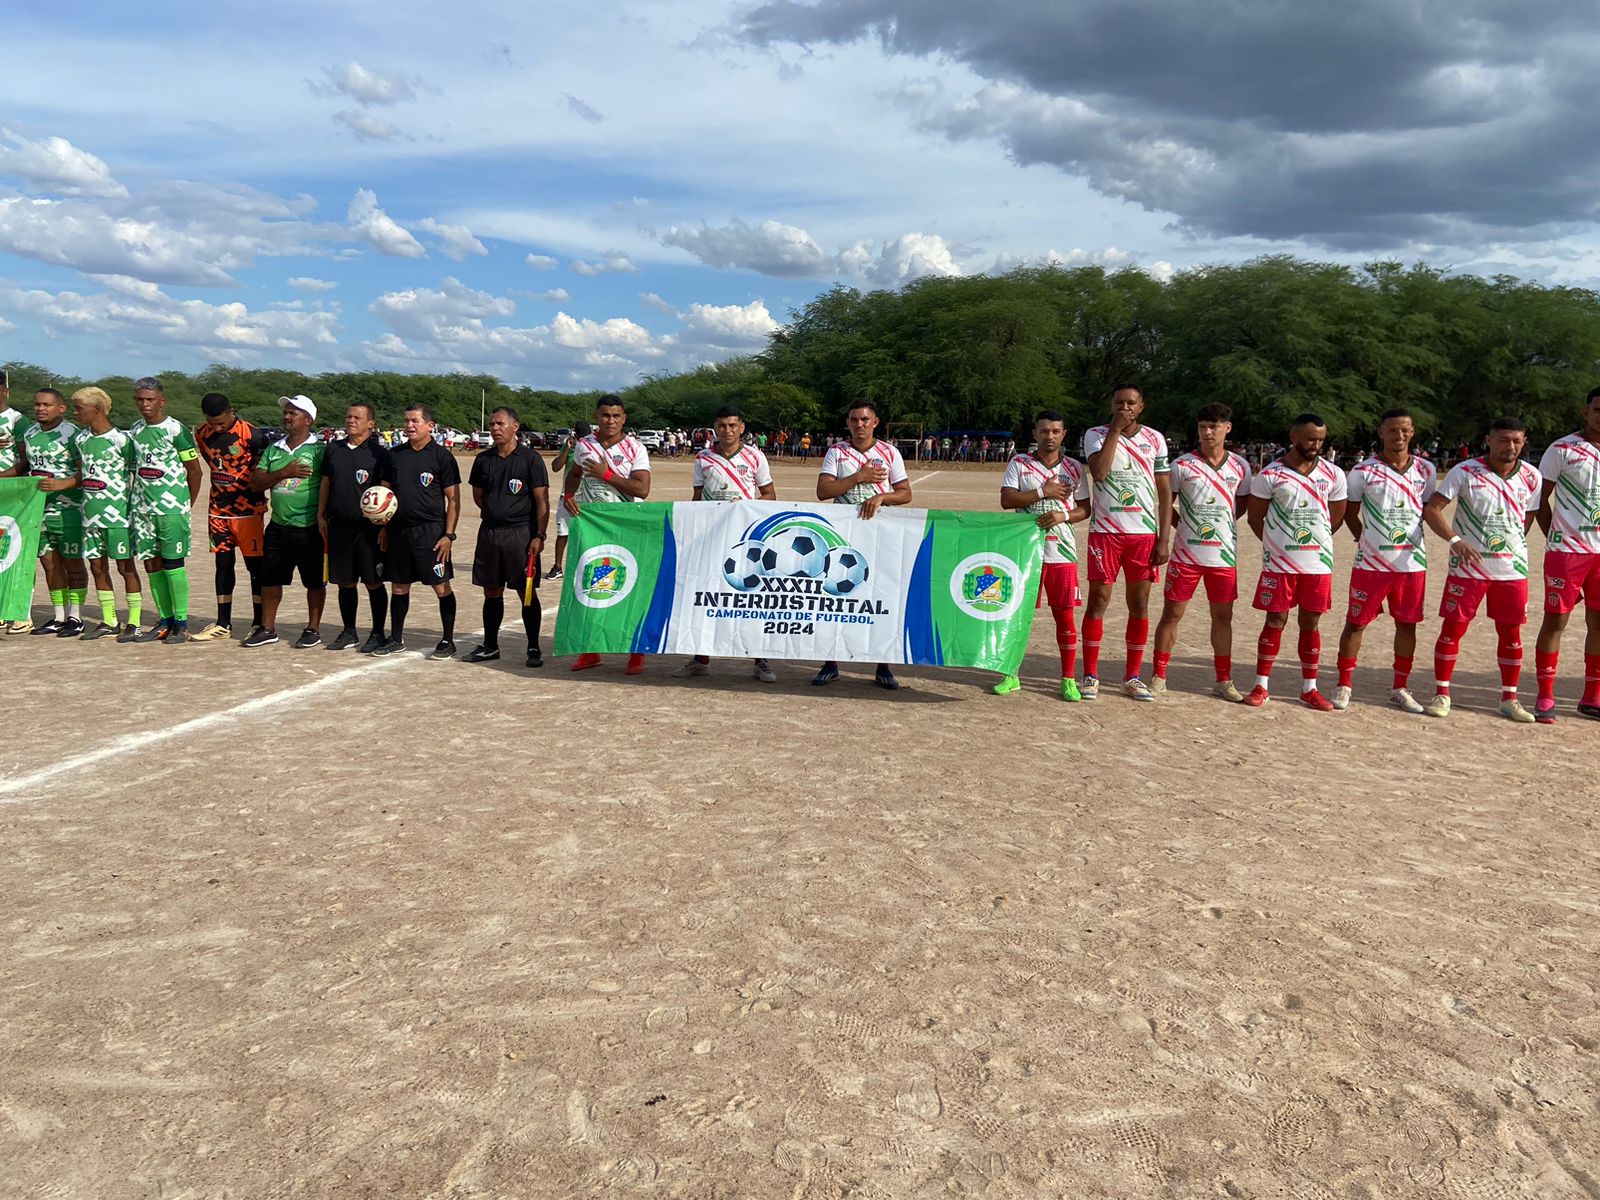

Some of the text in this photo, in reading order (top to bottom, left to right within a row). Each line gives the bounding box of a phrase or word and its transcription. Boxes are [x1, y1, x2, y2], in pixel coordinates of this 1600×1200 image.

[34, 454, 44, 466] 13
[146, 453, 152, 464] 8
[189, 450, 196, 458] C
[89, 463, 96, 475] 6
[218, 457, 223, 470] 1
[63, 542, 79, 554] 13
[117, 541, 126, 554] 6
[175, 541, 183, 554] 8
[251, 538, 257, 551] 1
[760, 577, 824, 595] XXXII
[694, 591, 889, 615] INTERDISTRITAL
[706, 608, 874, 625] CAMPEONATO DE FUTEBOL
[763, 622, 814, 635] 2024
